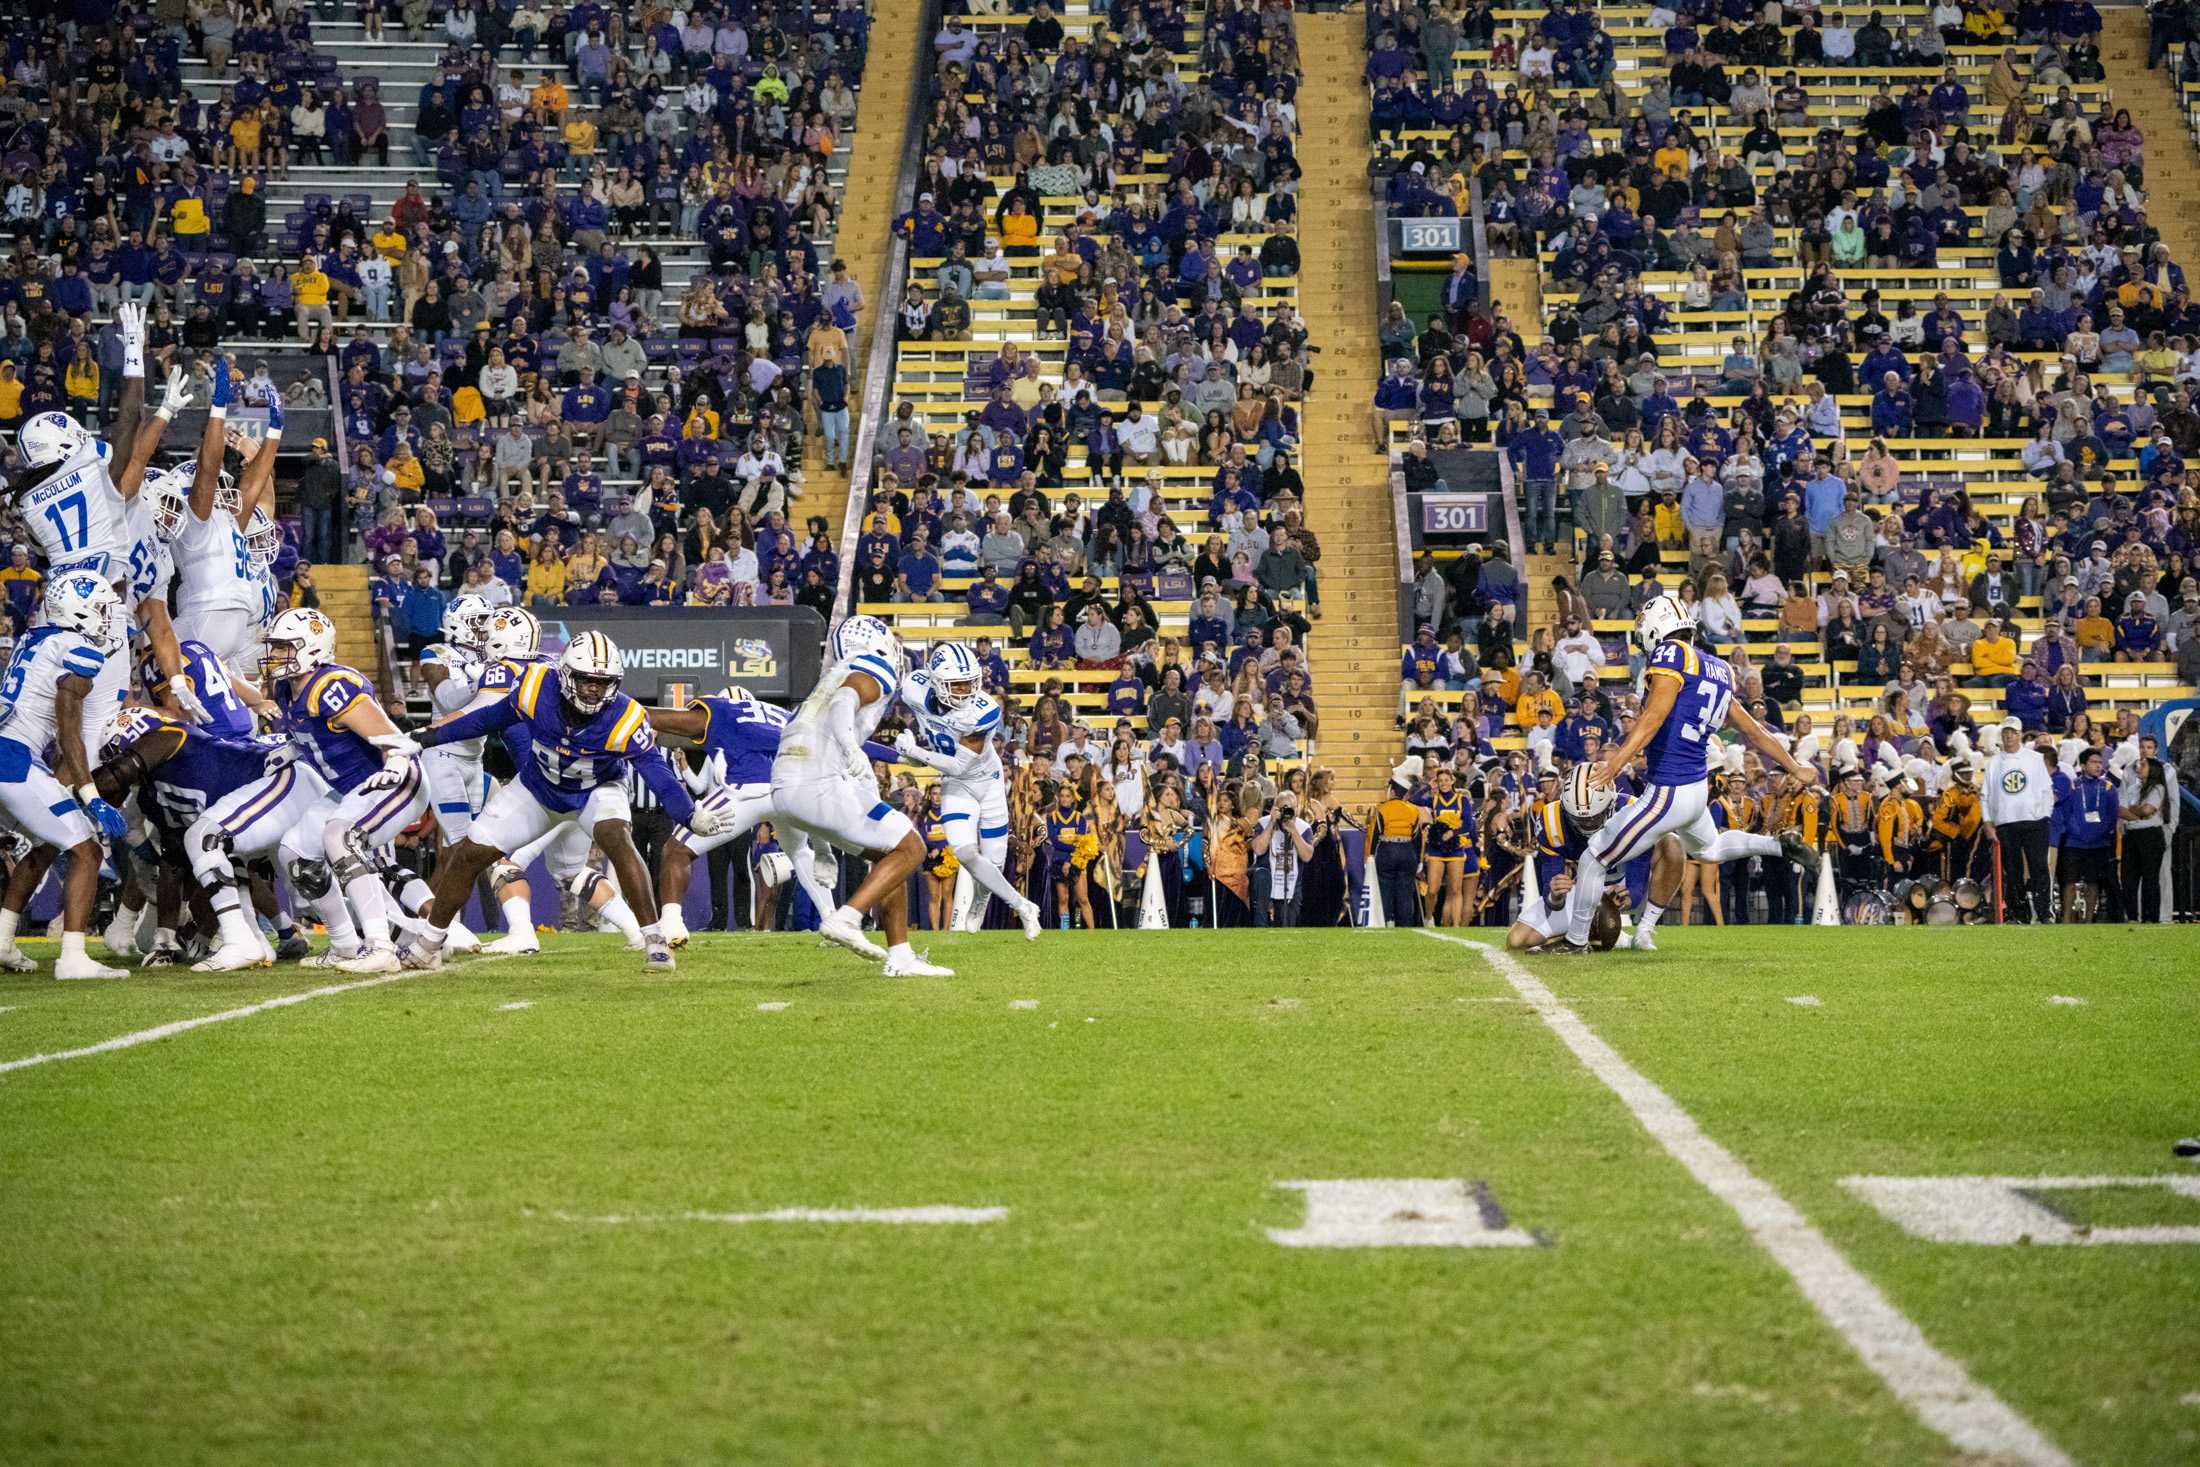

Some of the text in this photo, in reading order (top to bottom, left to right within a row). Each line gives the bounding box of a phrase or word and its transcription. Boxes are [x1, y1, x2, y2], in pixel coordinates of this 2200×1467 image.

[984, 146, 1005, 159] LSU
[55, 201, 66, 218] 2
[1497, 202, 1507, 218] 7
[1411, 228, 1453, 247] 301
[204, 282, 224, 294] LSU
[577, 395, 594, 404] LSU
[44, 490, 88, 552] 17
[1434, 506, 1477, 529] 301
[1240, 541, 1260, 550] LSU
[129, 539, 157, 600] 52
[1343, 568, 1355, 576] 16
[1165, 581, 1187, 589] LSU
[1344, 592, 1356, 600] 15
[622, 649, 718, 667] WERADE
[1652, 645, 1676, 663] 34
[145, 658, 160, 682] 4
[485, 667, 506, 686] 66
[730, 661, 776, 677] LSU
[1704, 661, 1729, 684] RAMOS
[323, 681, 350, 712] 67
[976, 697, 989, 709] 18
[729, 698, 791, 727] 35
[1348, 710, 1361, 718] 10
[1681, 680, 1732, 742] 34
[124, 717, 150, 741] 50
[1579, 725, 1601, 736] LSU
[294, 732, 339, 780] 7
[532, 739, 597, 789] 94
[2005, 774, 2026, 789] SEC
[1356, 805, 1363, 813] 6
[1158, 908, 1168, 928] LSU
